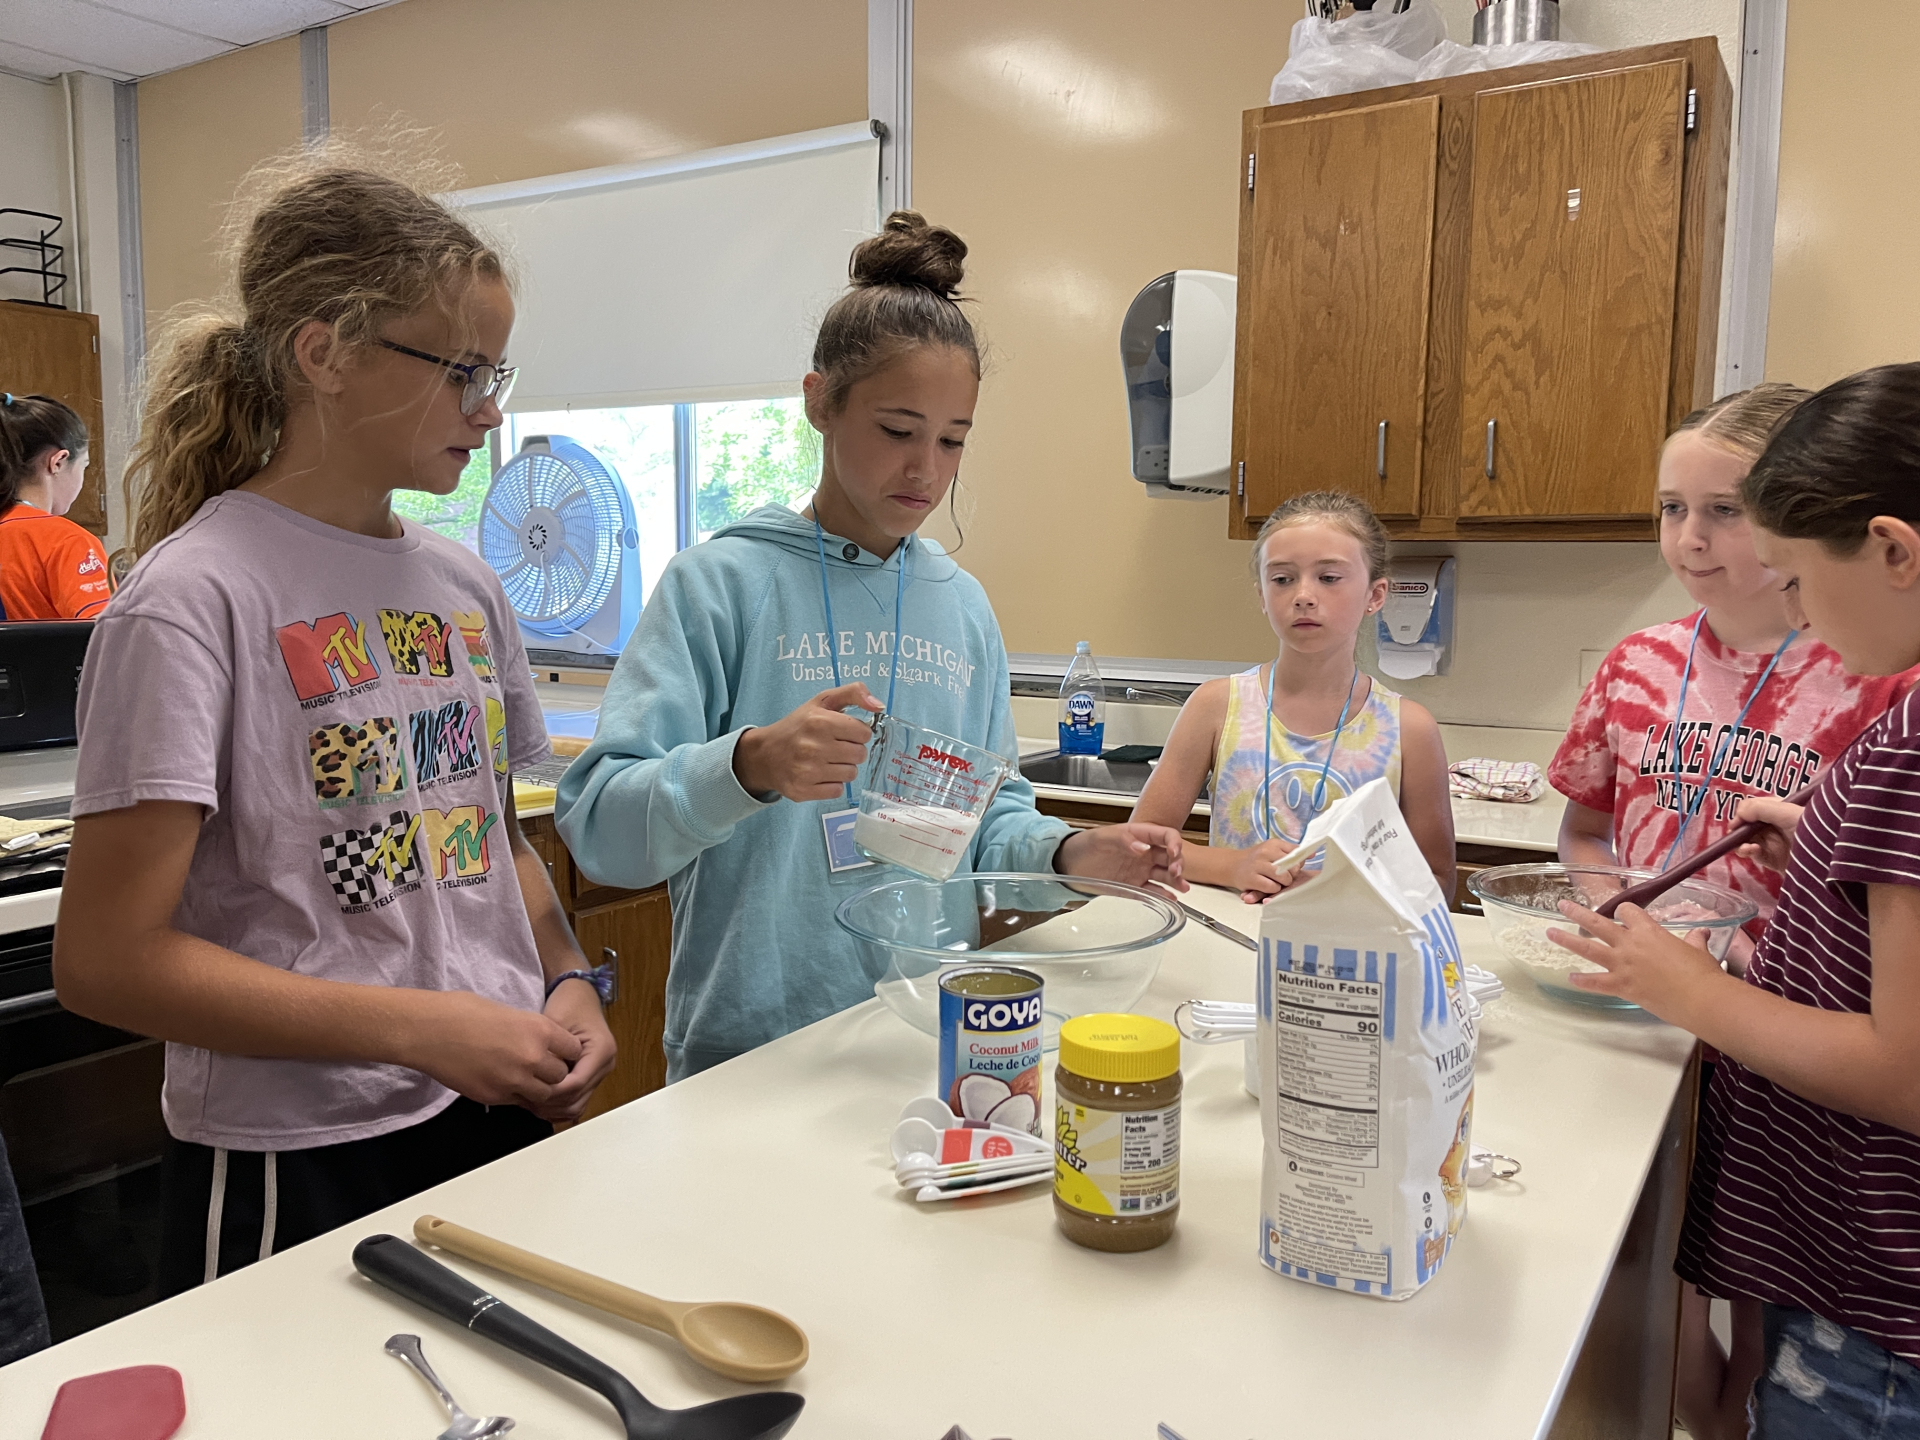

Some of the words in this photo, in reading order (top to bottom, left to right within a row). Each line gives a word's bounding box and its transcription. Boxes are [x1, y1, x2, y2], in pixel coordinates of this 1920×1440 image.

[275, 612, 381, 701] MTV
[376, 609, 454, 677] MTV
[776, 631, 854, 660] LAKE
[792, 660, 870, 681] Unsalted
[878, 663, 890, 677] &
[895, 662, 942, 688] Shark
[300, 694, 336, 710] MUSIC
[1069, 700, 1094, 709] DAWN
[408, 700, 481, 784] MTV
[308, 717, 408, 800] MTV
[1639, 722, 1712, 776] LAKE
[1707, 724, 1822, 798] GEORGE
[438, 769, 477, 786] TELEVISION
[1655, 778, 1709, 816] NEW
[1714, 789, 1756, 821] YO
[878, 812, 886, 820] 150
[422, 804, 498, 881] MTV
[320, 810, 424, 905] MTV
[443, 876, 488, 890] TELEVISION
[340, 904, 370, 914] MUSIC
[373, 882, 422, 908] TELEVISION
[1279, 973, 1334, 991] Nutrition
[1339, 982, 1378, 996] Facts
[967, 996, 1041, 1030] GOYA
[1278, 1011, 1322, 1028] Calories
[1358, 1022, 1378, 1033] 90
[970, 1042, 1018, 1056] Coconut
[1022, 1036, 1039, 1052] Milk
[969, 1058, 1003, 1071] Leche
[1006, 1058, 1018, 1070] de
[1022, 1054, 1040, 1066] Coco
[1125, 1116, 1158, 1124] Nutrition
[1148, 1159, 1161, 1168] 200
